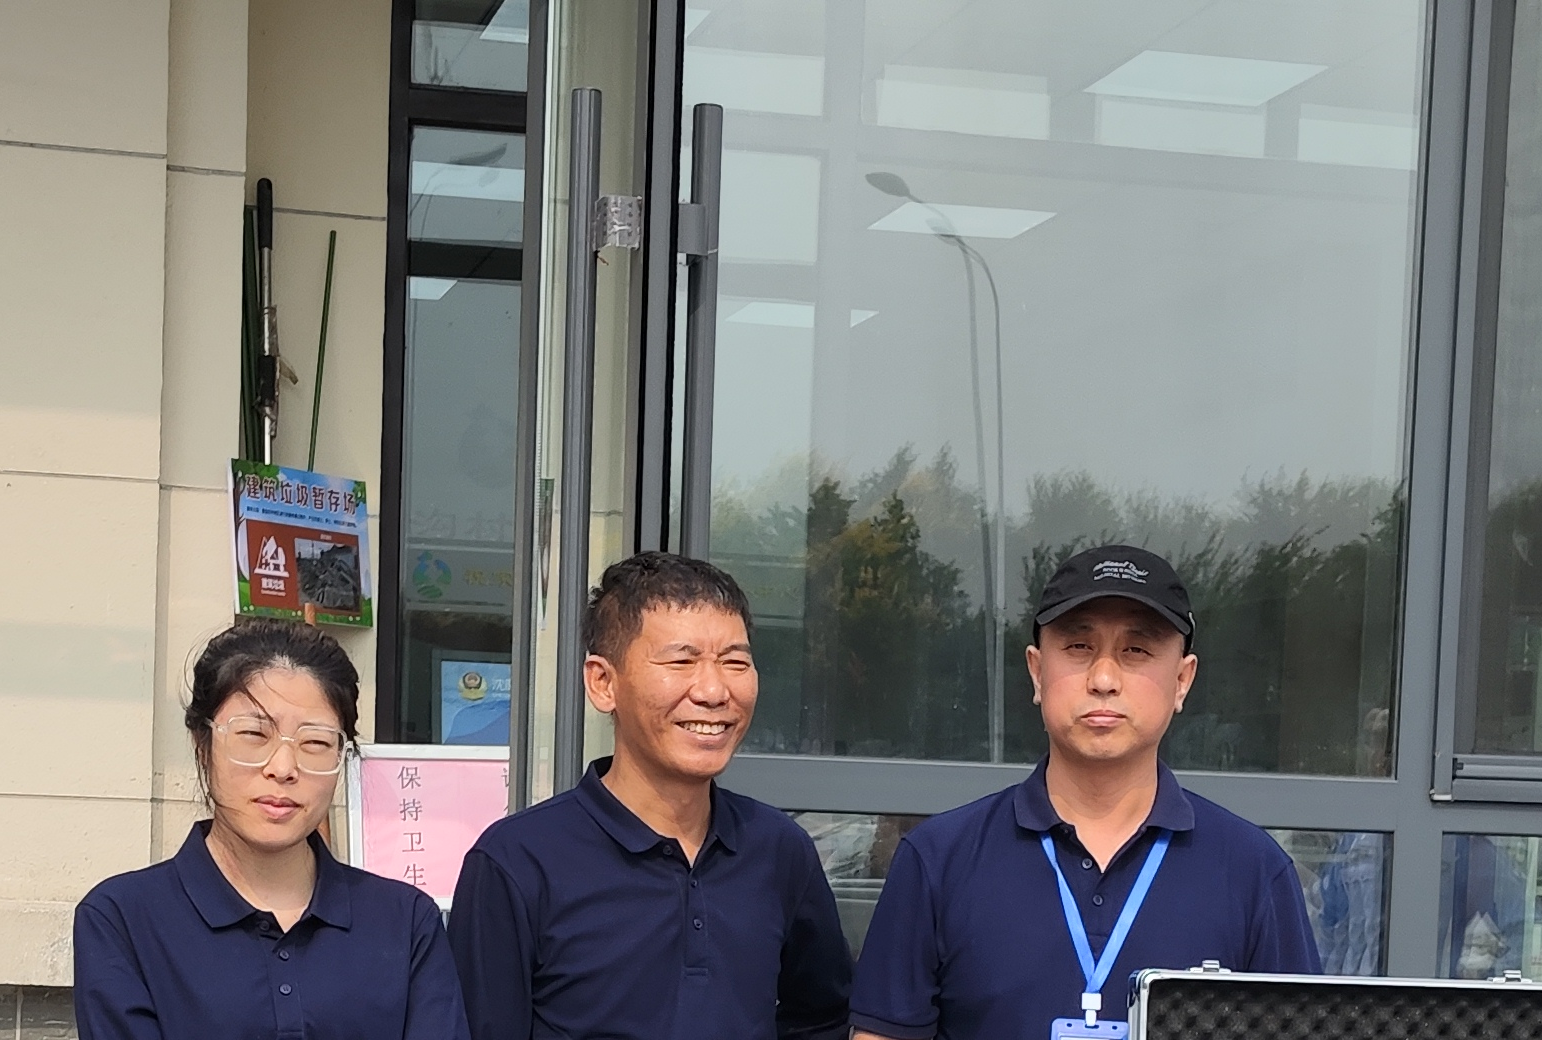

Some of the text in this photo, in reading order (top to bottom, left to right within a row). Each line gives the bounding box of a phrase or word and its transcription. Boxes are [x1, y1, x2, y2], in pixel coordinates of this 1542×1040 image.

[246, 473, 357, 516] 建筑垃圾暂存场
[397, 765, 427, 887] 保持卫生
